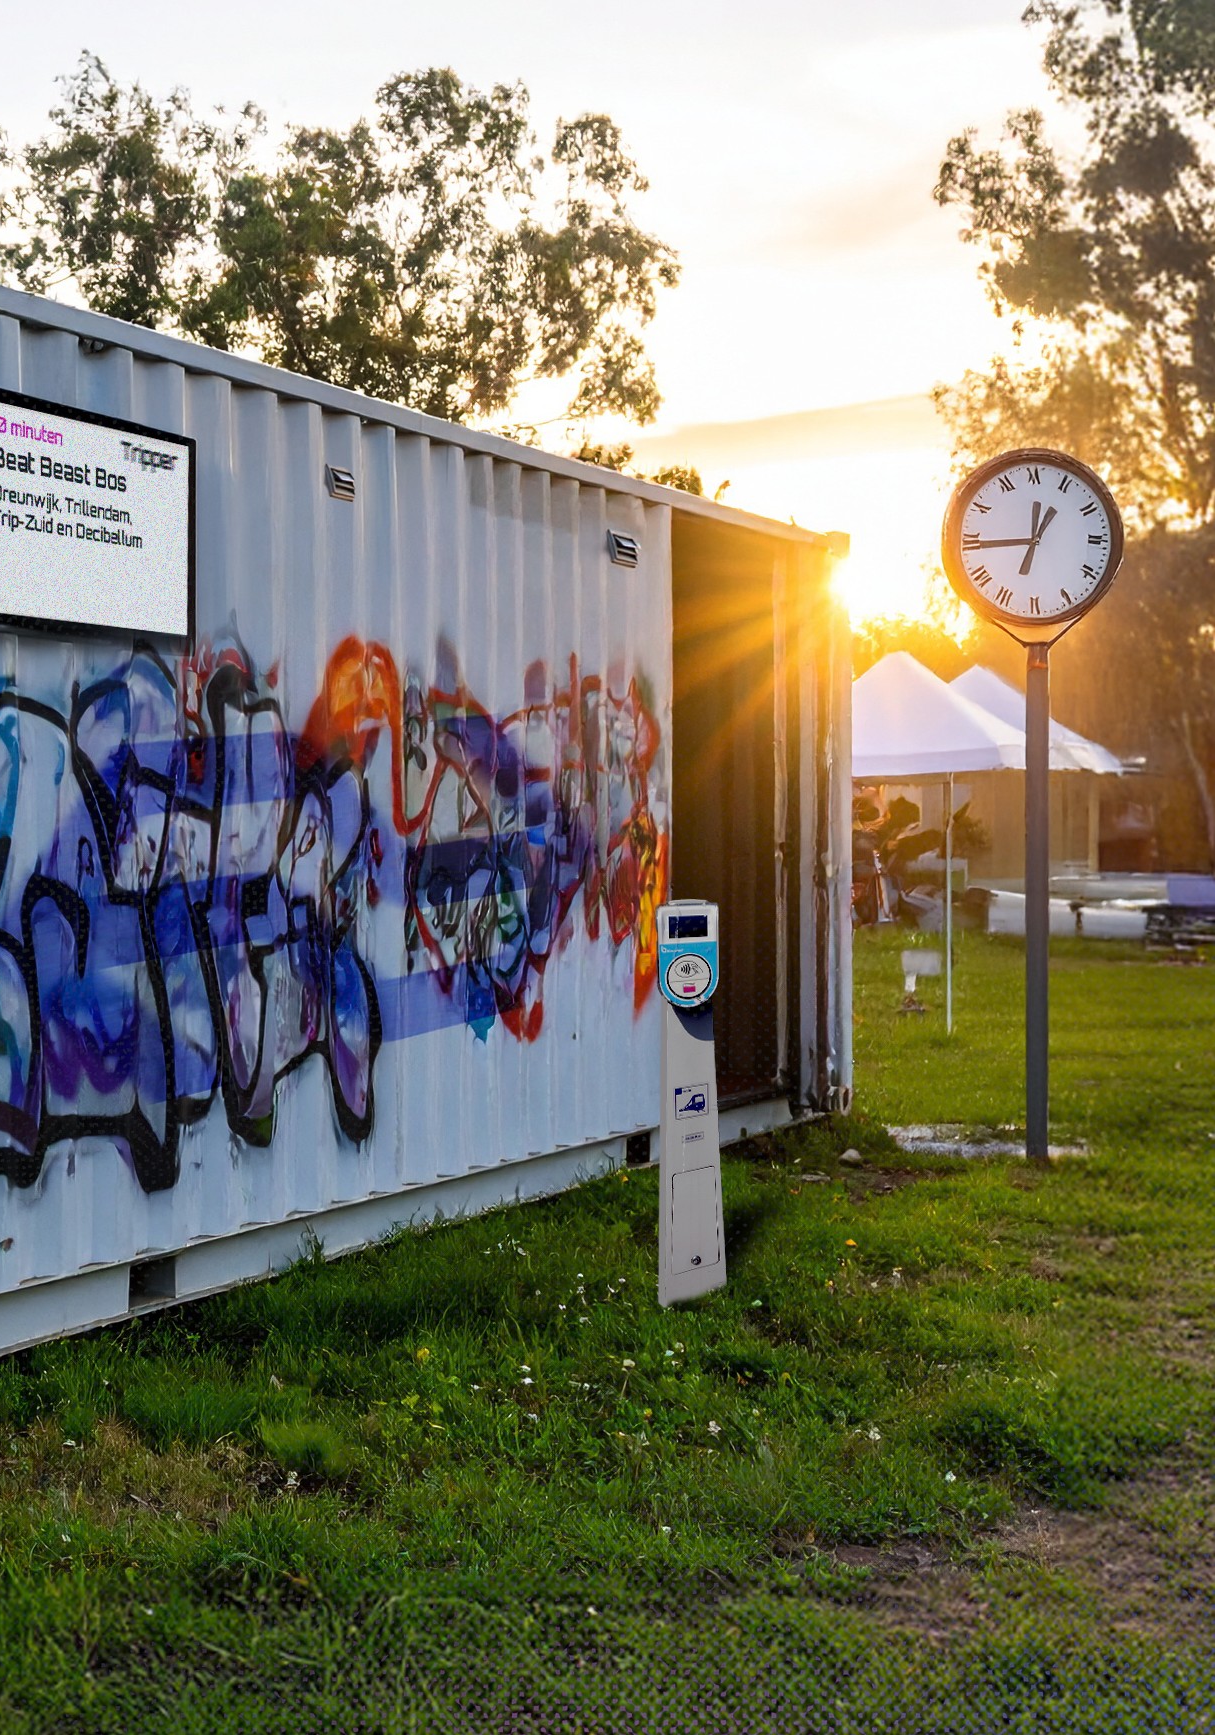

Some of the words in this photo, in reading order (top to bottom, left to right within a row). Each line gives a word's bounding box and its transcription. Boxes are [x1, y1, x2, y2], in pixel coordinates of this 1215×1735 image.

[10, 420, 63, 446] minuten
[121, 440, 178, 473] Tripper
[40, 456, 90, 486] Beast
[95, 467, 127, 492] Bos
[65, 497, 133, 526] Trillendam,
[57, 522, 73, 538] en
[76, 522, 143, 549] Decibellum
